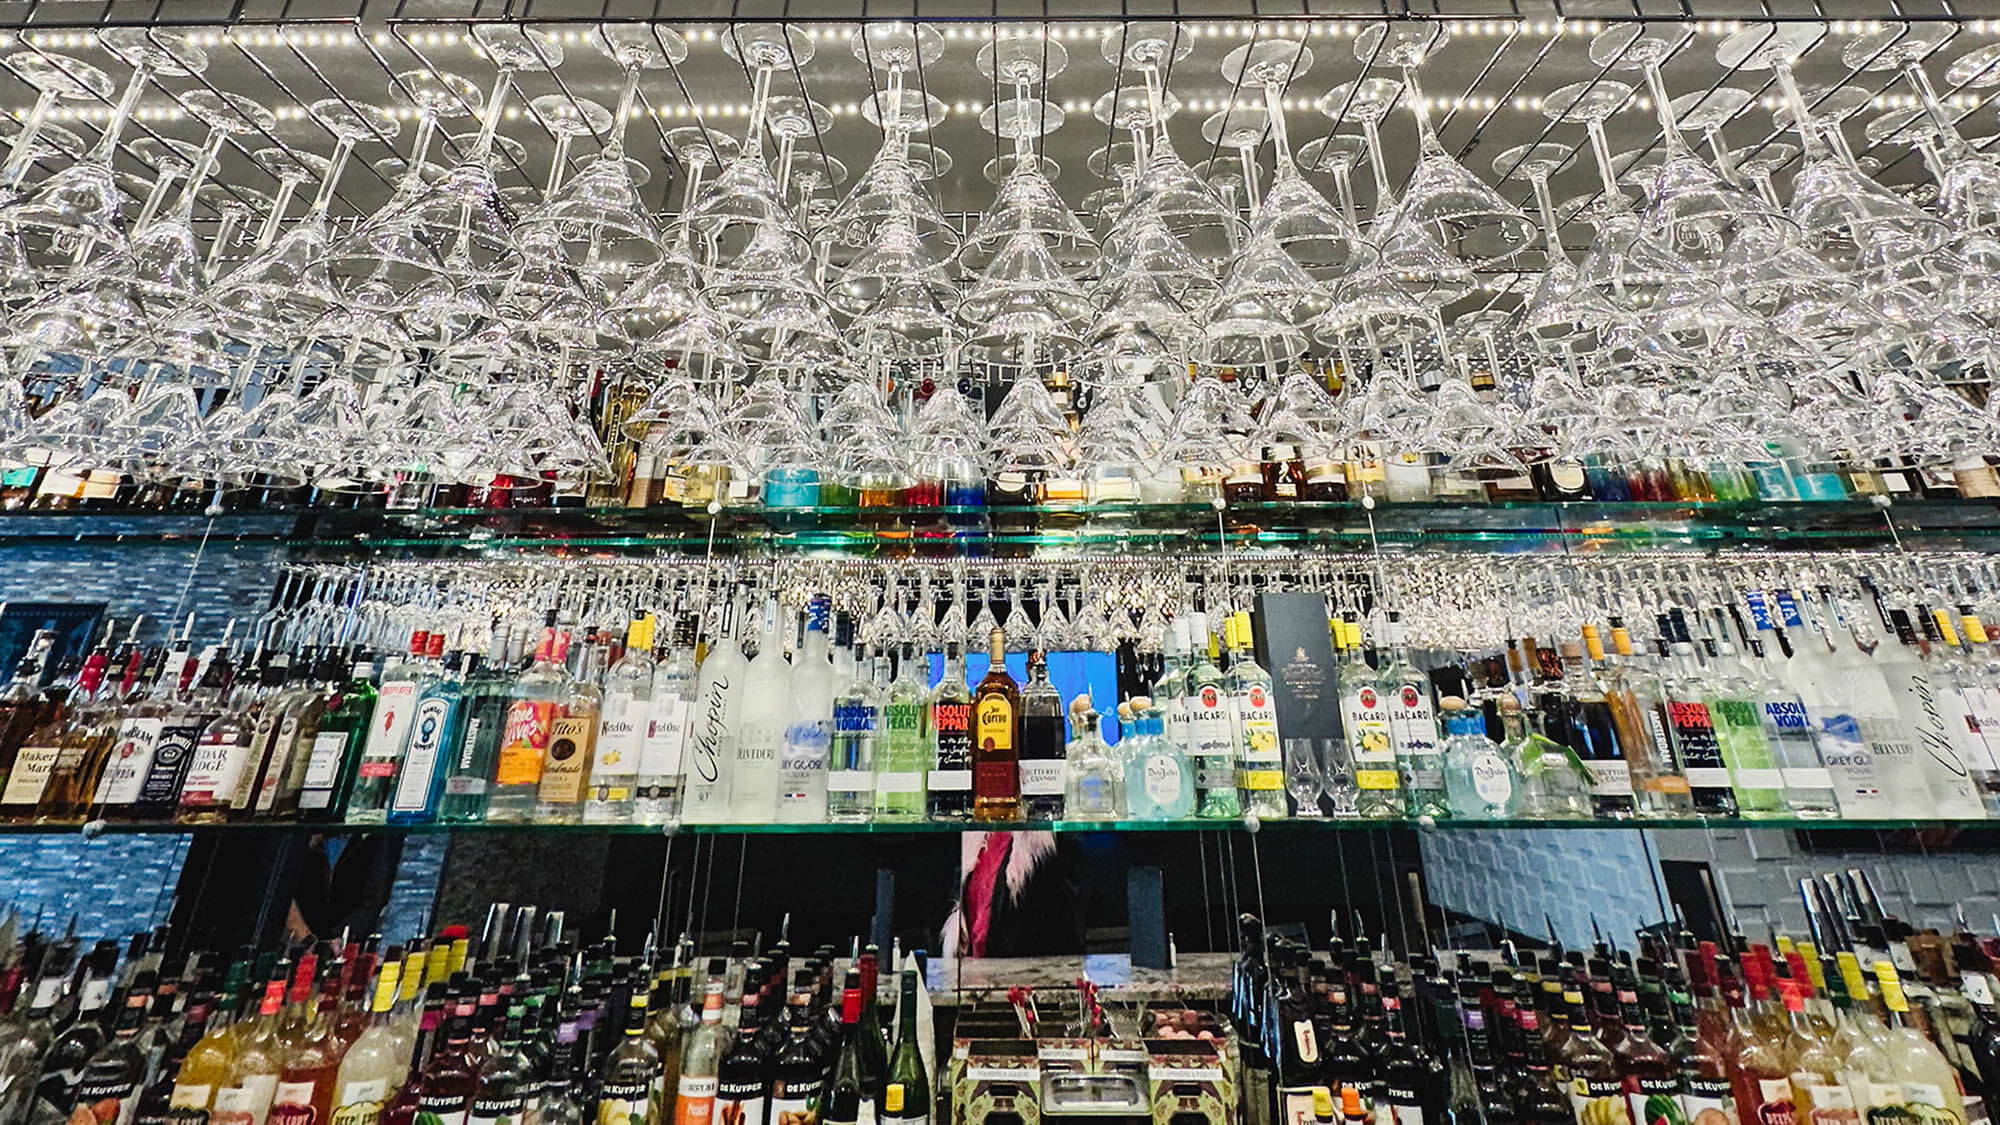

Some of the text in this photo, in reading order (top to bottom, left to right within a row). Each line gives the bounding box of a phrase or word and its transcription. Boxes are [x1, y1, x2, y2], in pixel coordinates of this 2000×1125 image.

[1193, 711, 1226, 721] BACARD
[1240, 711, 1273, 721] BACARD
[1352, 711, 1386, 722] BACARD
[552, 721, 584, 735] Tito's
[693, 674, 729, 782] Chopin
[1908, 675, 1967, 777] Chopin
[730, 1082, 762, 1094] KUYPER
